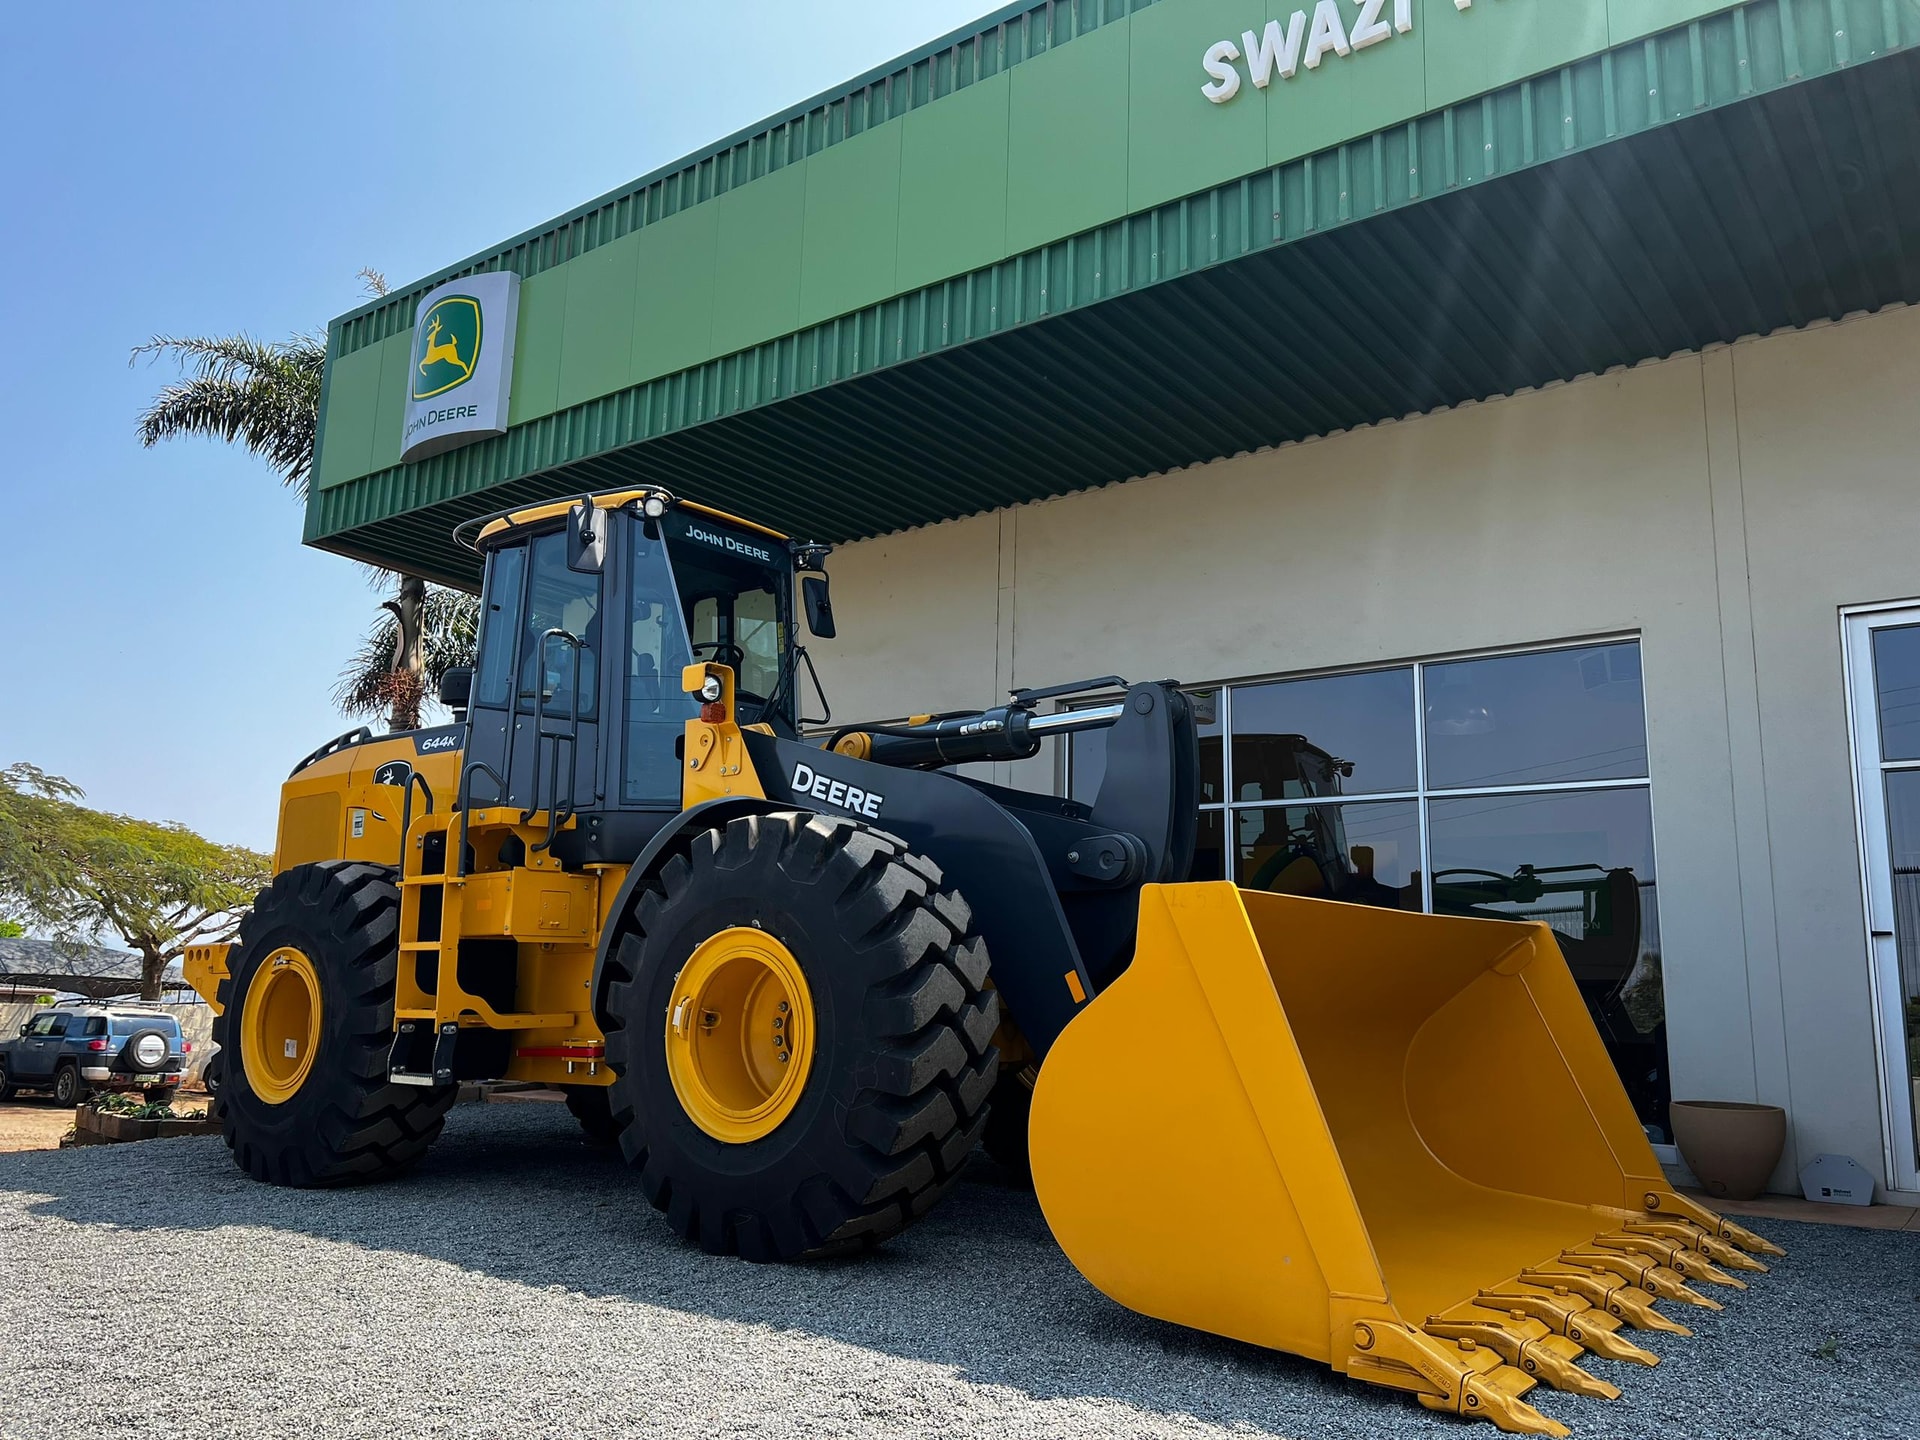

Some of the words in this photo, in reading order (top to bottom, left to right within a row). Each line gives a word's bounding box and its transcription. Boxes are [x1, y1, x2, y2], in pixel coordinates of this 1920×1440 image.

[405, 416, 426, 440] JOHN
[428, 405, 478, 426] DEERE
[685, 525, 723, 548] JOHN
[725, 536, 770, 562] DEERE
[422, 735, 457, 750] 644K
[791, 763, 884, 819] DEERE
